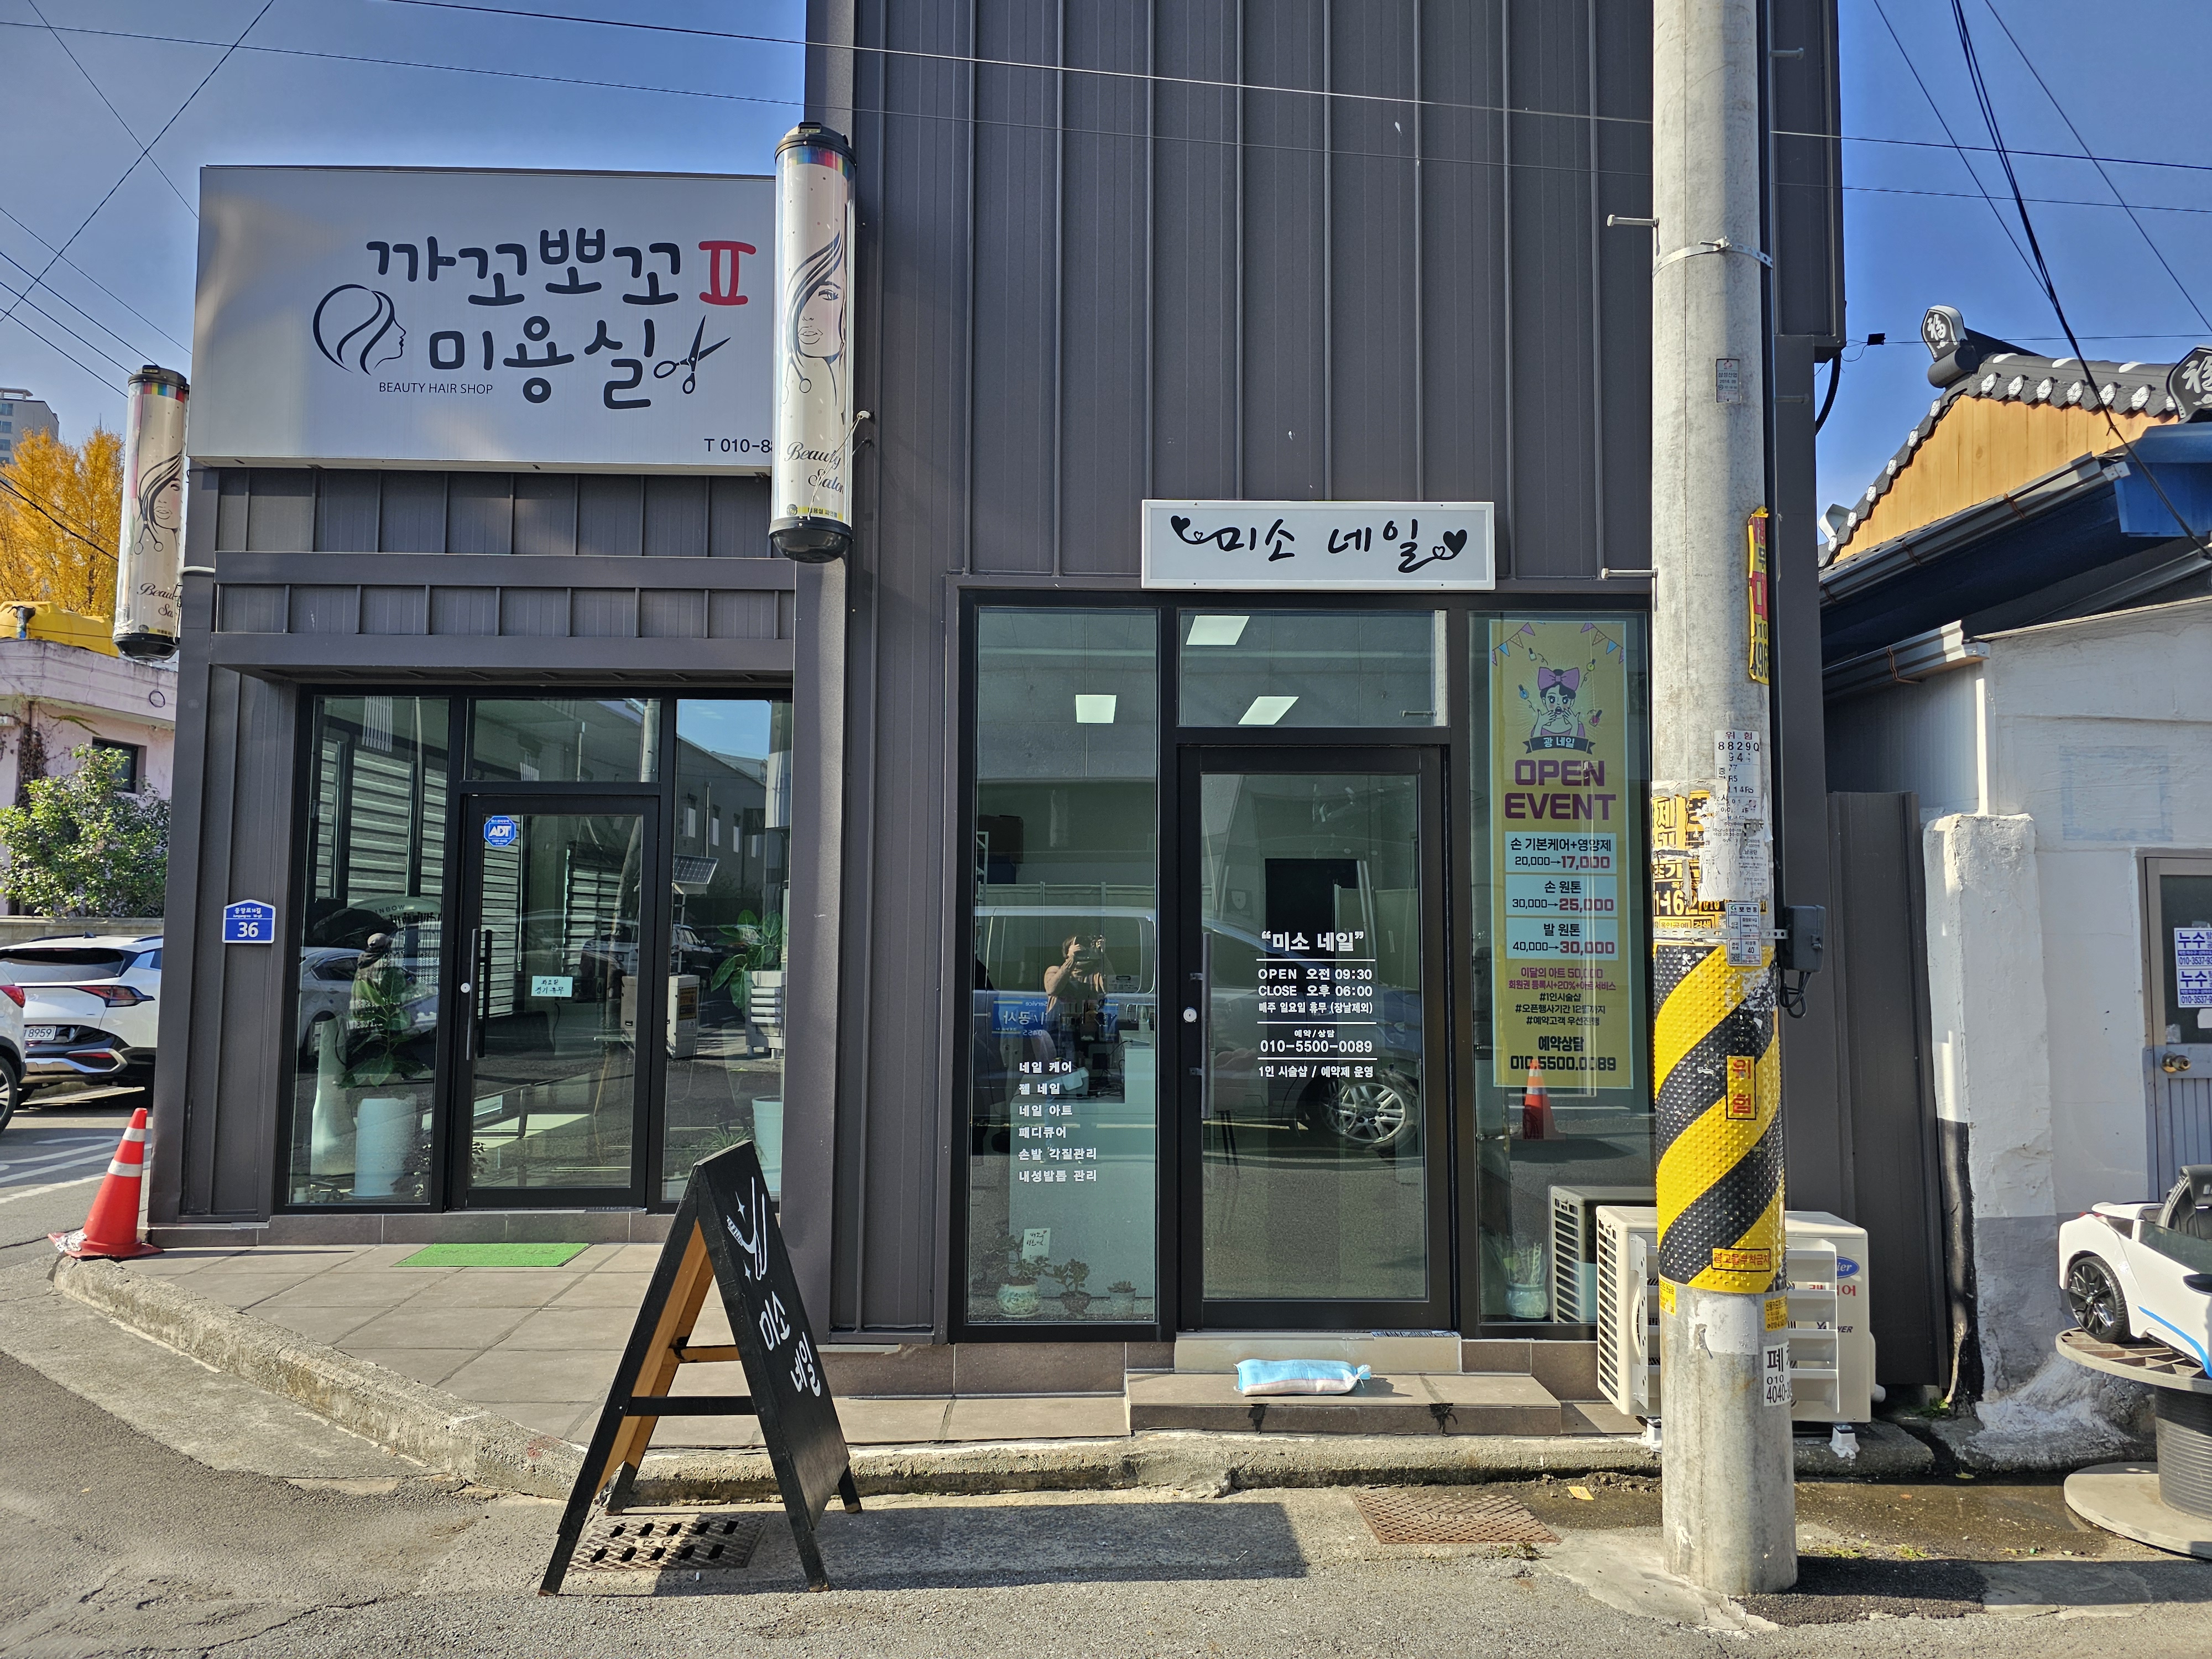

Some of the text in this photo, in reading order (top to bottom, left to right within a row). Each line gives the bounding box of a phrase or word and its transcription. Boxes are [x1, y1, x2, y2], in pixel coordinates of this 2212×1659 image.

[366, 227, 681, 306] 까꼬뽀꼬
[429, 315, 654, 410] 미용실
[379, 382, 493, 394] BEAUTY HAIR SHOP
[704, 438, 715, 452] T
[784, 441, 841, 470] Beauty
[1216, 518, 1437, 573] 미소 네일
[1556, 737, 1575, 748] 네일
[1515, 759, 1605, 787] OPEN
[1505, 792, 1616, 820] EVENT
[489, 825, 512, 837] ADT
[1510, 837, 1611, 852] 손 기본케어+영양제
[1515, 855, 1610, 870] 20,000 17,000
[1545, 880, 1582, 894] 손 원톤
[1512, 898, 1614, 913] 30,000 25,000
[237, 921, 259, 938] 36
[1543, 923, 1580, 937] 발 원톤
[2178, 932, 2206, 949] 누수
[1512, 941, 1615, 956] 40,000 30,000
[1258, 968, 1373, 980] OPEN 오전 09:30
[1521, 967, 1547, 978] 이달의
[1548, 968, 1566, 978] 아트
[2180, 971, 2208, 988] 누수
[550, 987, 565, 995] 휴무
[1258, 984, 1373, 997] CLOSE 오후 06:00
[1259, 1001, 1373, 1014] 매주 일요일 휴무 (장날제외)
[1294, 1029, 1335, 1038] 예약/상담
[1260, 1040, 1373, 1053] 010-5500-0089
[1538, 1036, 1584, 1052] 예약상담
[1019, 1061, 1073, 1074] 네일 케어
[1259, 1066, 1275, 1077] 1인
[1278, 1066, 1308, 1078] 시술샵
[1321, 1066, 1350, 1078] 예약제
[1354, 1066, 1374, 1078] 운영
[1018, 1083, 1061, 1095] 젤 네일
[1018, 1104, 1073, 1117] 네일 아트
[1018, 1126, 1067, 1139] 패디큐어
[1018, 1147, 1097, 1161] 손발 각질관리
[1018, 1169, 1097, 1183] 내성발톱 관리
[759, 1291, 791, 1351] 미소
[790, 1331, 821, 1397] 네일
[1766, 1374, 1784, 1385] 010
